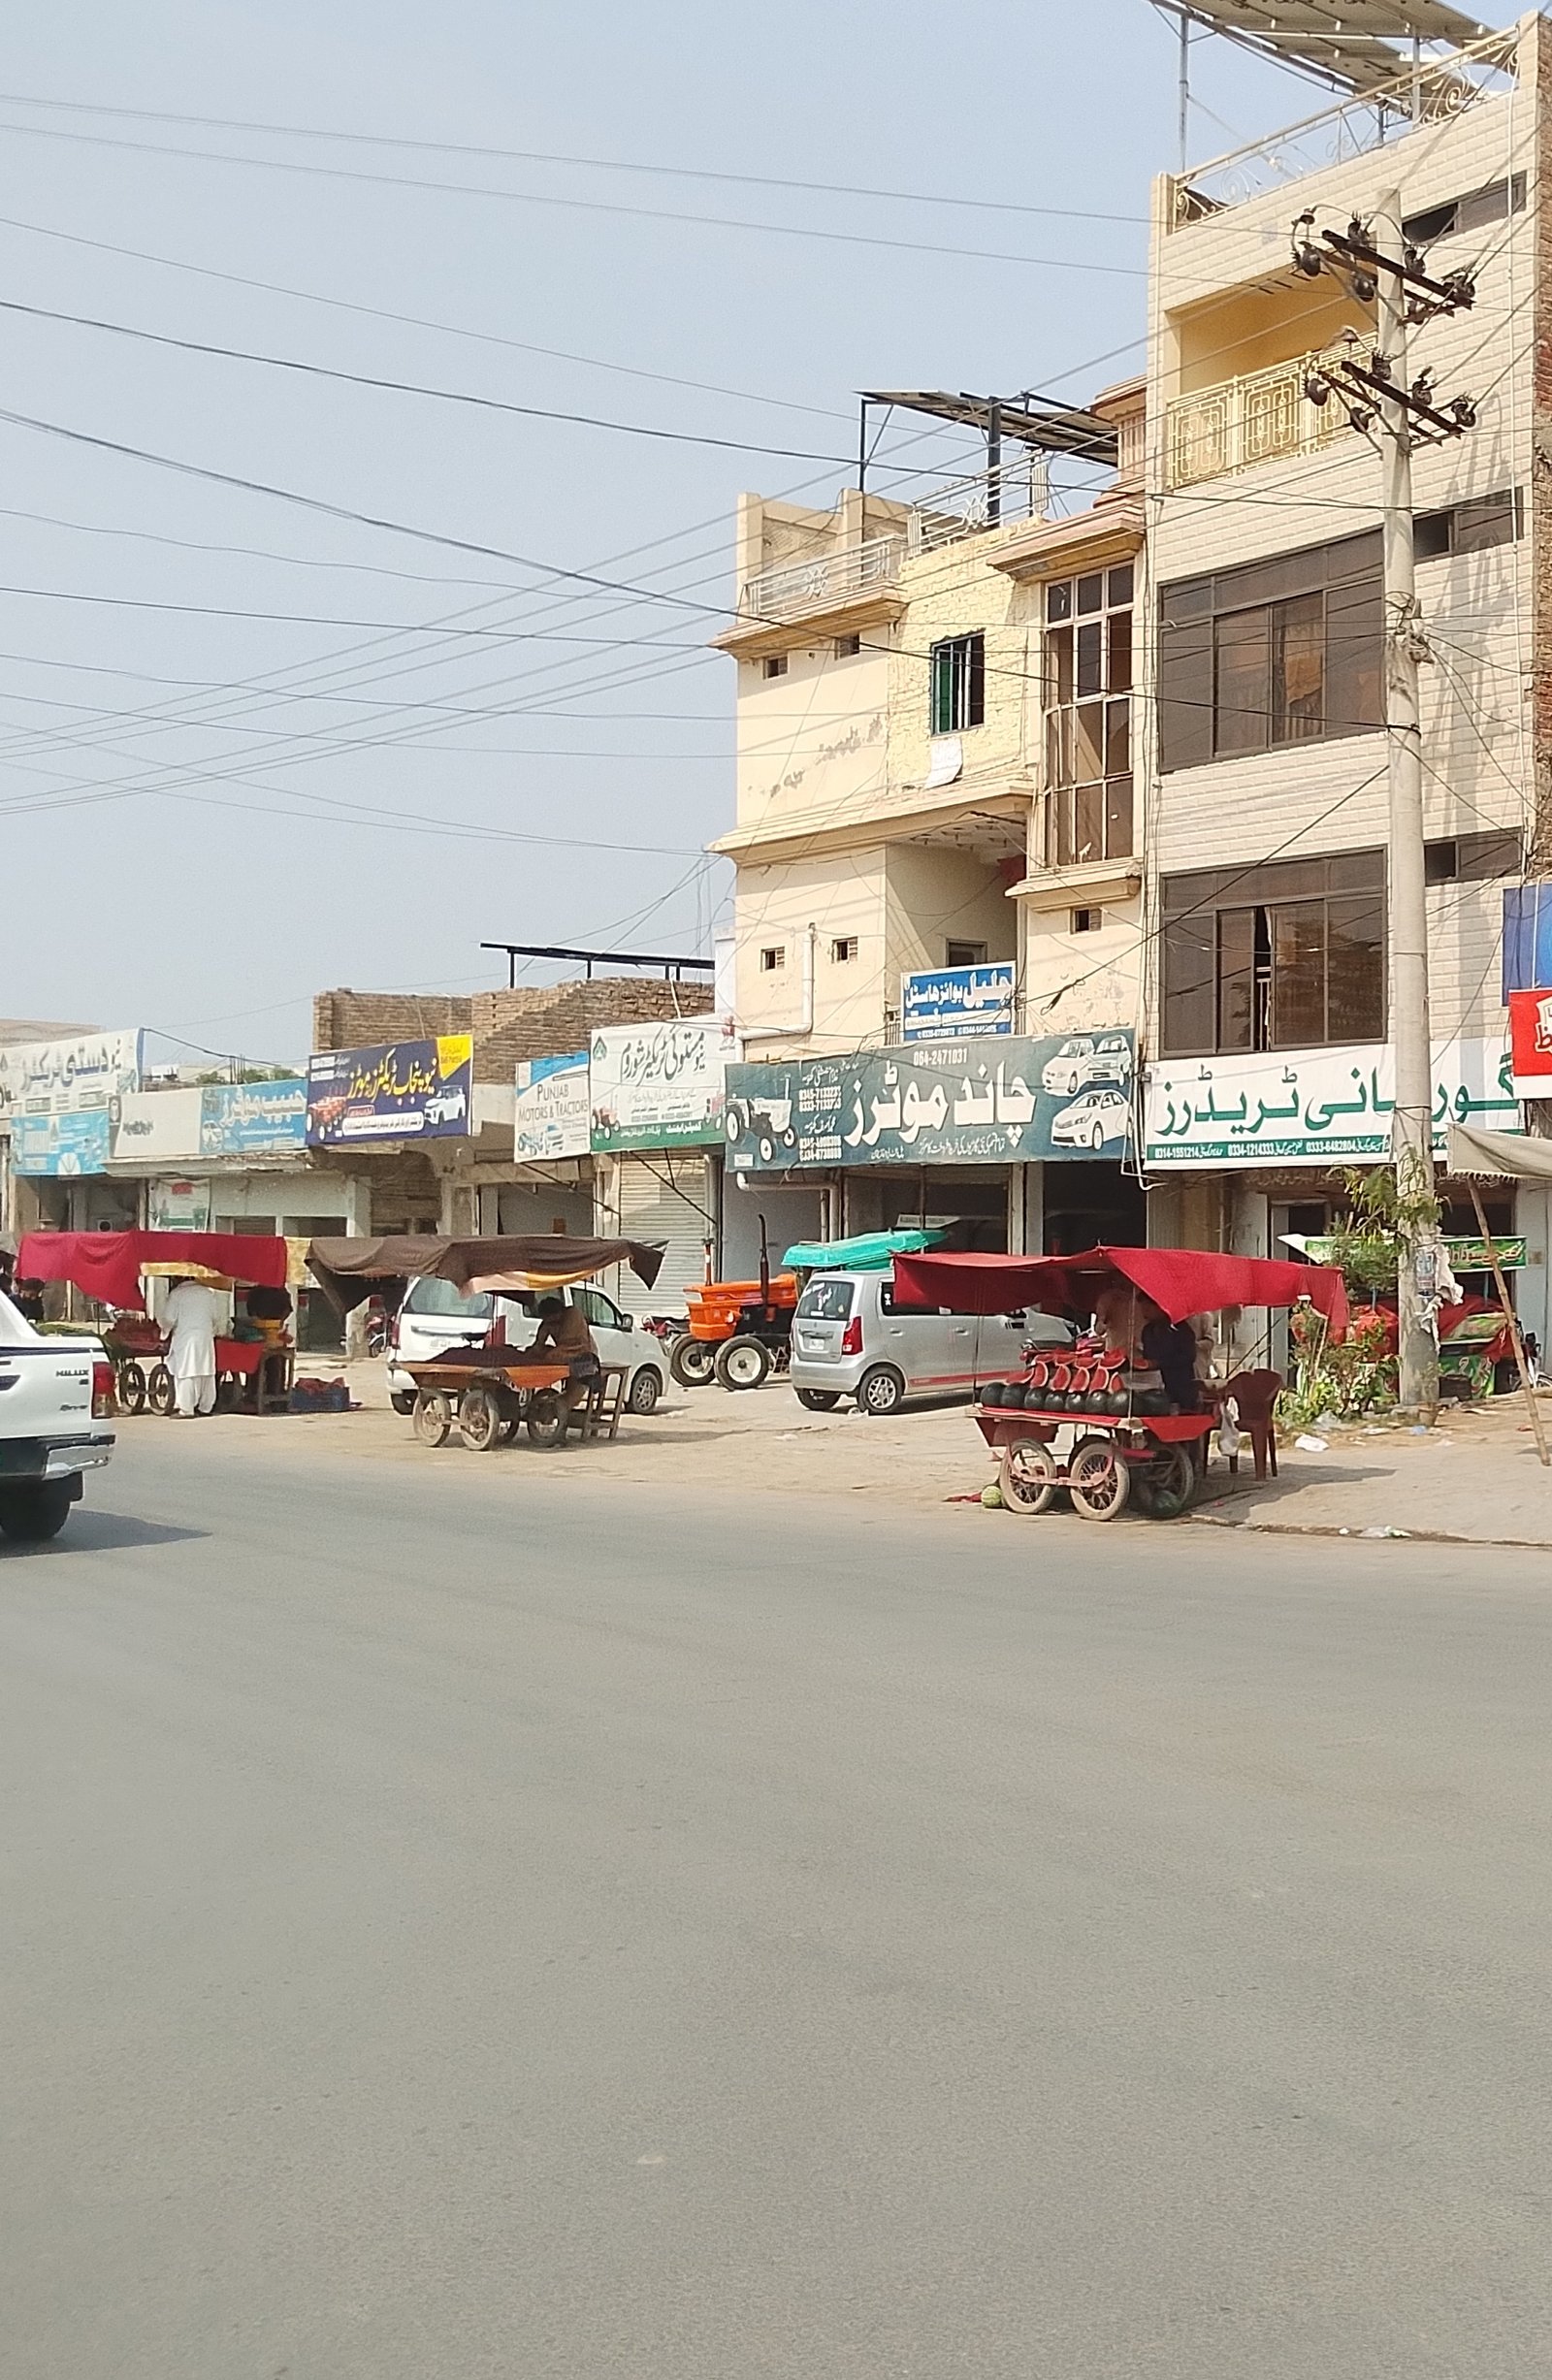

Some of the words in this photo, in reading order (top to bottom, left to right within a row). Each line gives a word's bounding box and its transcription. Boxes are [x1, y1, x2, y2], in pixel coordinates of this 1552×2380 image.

[536, 1083, 569, 1102] PUNJAB
[913, 1047, 968, 1066] 064-2471031
[1305, 1051, 1520, 1130] گورانی
[518, 1106, 548, 1122] MOTORS
[555, 1099, 589, 1118] TRACTORS
[843, 1060, 950, 1147] موٹرز
[954, 1061, 1036, 1148] چاند
[1154, 1063, 1300, 1136] ٹریڈرز
